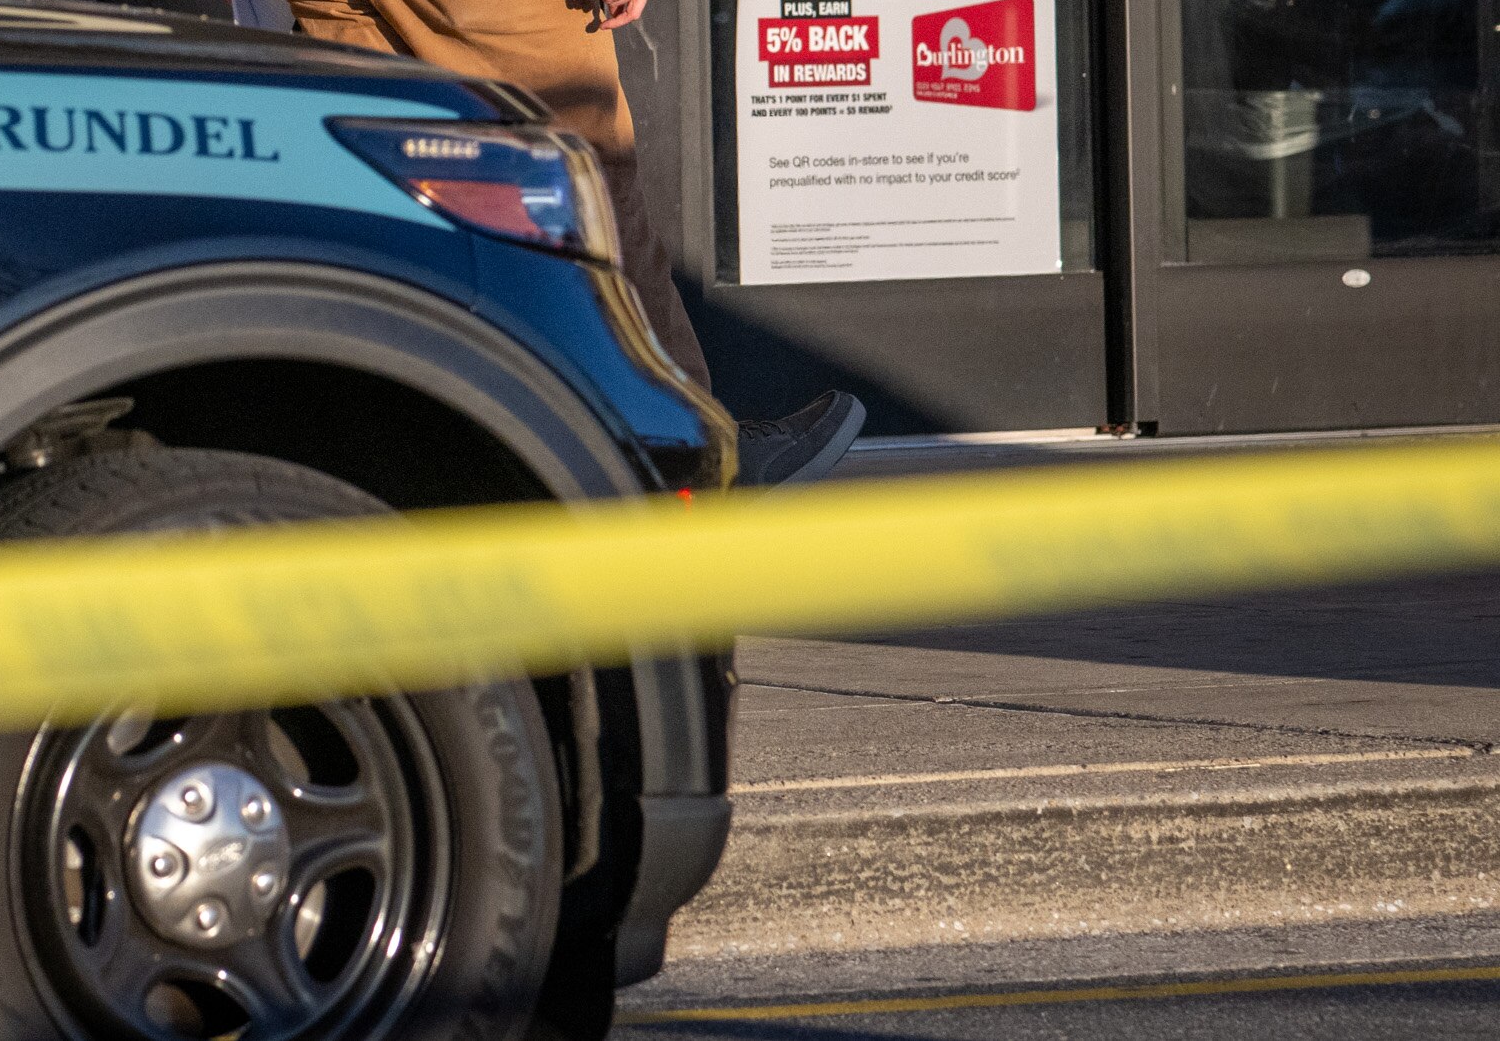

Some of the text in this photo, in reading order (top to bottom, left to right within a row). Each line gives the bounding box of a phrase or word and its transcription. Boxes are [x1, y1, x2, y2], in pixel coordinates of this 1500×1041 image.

[784, 1, 849, 18] PLUS, EARN
[766, 25, 870, 54] 5% BACK
[916, 42, 1025, 73] Burlington
[773, 63, 867, 83] IN REWARDS
[751, 95, 777, 104] THAT'S
[785, 95, 807, 103] POINT
[809, 94, 824, 103] FOR
[826, 94, 849, 102] EVERY
[863, 92, 887, 102] SPENT
[751, 108, 767, 117] AND
[769, 108, 792, 117] EVERY
[810, 107, 837, 116] POINTS
[769, 152, 969, 168] See QR codes in-store to see if you're
[769, 174, 831, 189] prequalified
[834, 173, 857, 185] with
[859, 175, 873, 184] no
[875, 172, 912, 187] impact
[915, 172, 926, 183] to
[928, 173, 952, 185] your
[954, 170, 984, 182] credit
